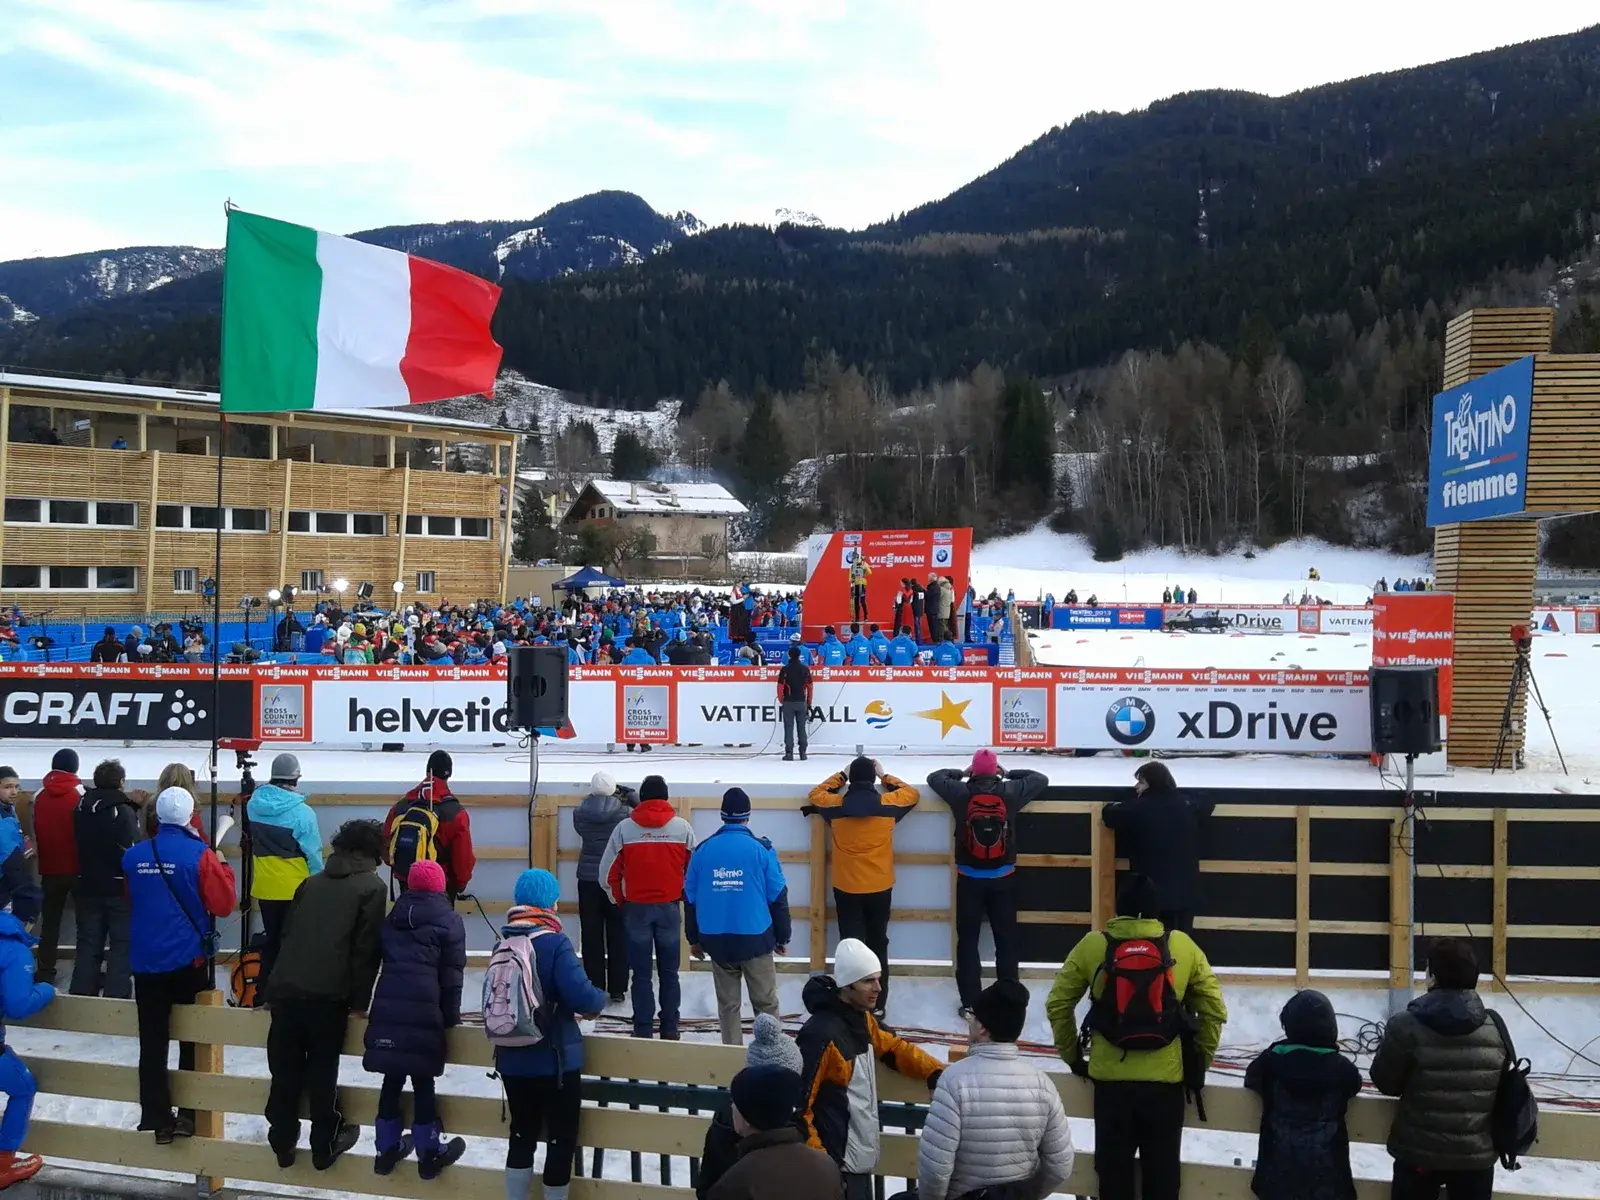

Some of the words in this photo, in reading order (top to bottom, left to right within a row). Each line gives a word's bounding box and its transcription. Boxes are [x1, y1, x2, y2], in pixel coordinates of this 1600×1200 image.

[1444, 394, 1516, 461] TRENTINO
[1443, 472, 1518, 508] fiemme
[869, 553, 925, 568] VIESSMANN
[1388, 628, 1452, 643] VIESSMANN
[22, 664, 73, 676] VIESSMANN
[80, 664, 130, 676] VIESSMANN
[138, 665, 190, 677] VIESSMANN
[257, 667, 309, 679] VIESSMANN
[316, 667, 369, 679] VIESSMANN
[376, 667, 429, 679] VIESSMANN
[436, 667, 489, 679] VIESSMANN
[619, 667, 673, 680] VIESSMANN
[681, 668, 735, 680] VIESSMANN
[868, 667, 923, 680] VIESSMANN
[931, 668, 987, 681] VIESSMANN
[996, 669, 1052, 683] VIESSMANN
[1060, 669, 1117, 683] VIESSMANN
[1126, 670, 1183, 683] VIESSMANN
[1192, 670, 1249, 684] VIESSMANN
[1259, 671, 1317, 685] VIESSMANN
[4, 692, 163, 726] CRAFT
[1110, 698, 1152, 714] BMW
[348, 697, 510, 732] helvetic
[701, 705, 857, 722] VATTEALL
[1177, 701, 1338, 741] xDrive
